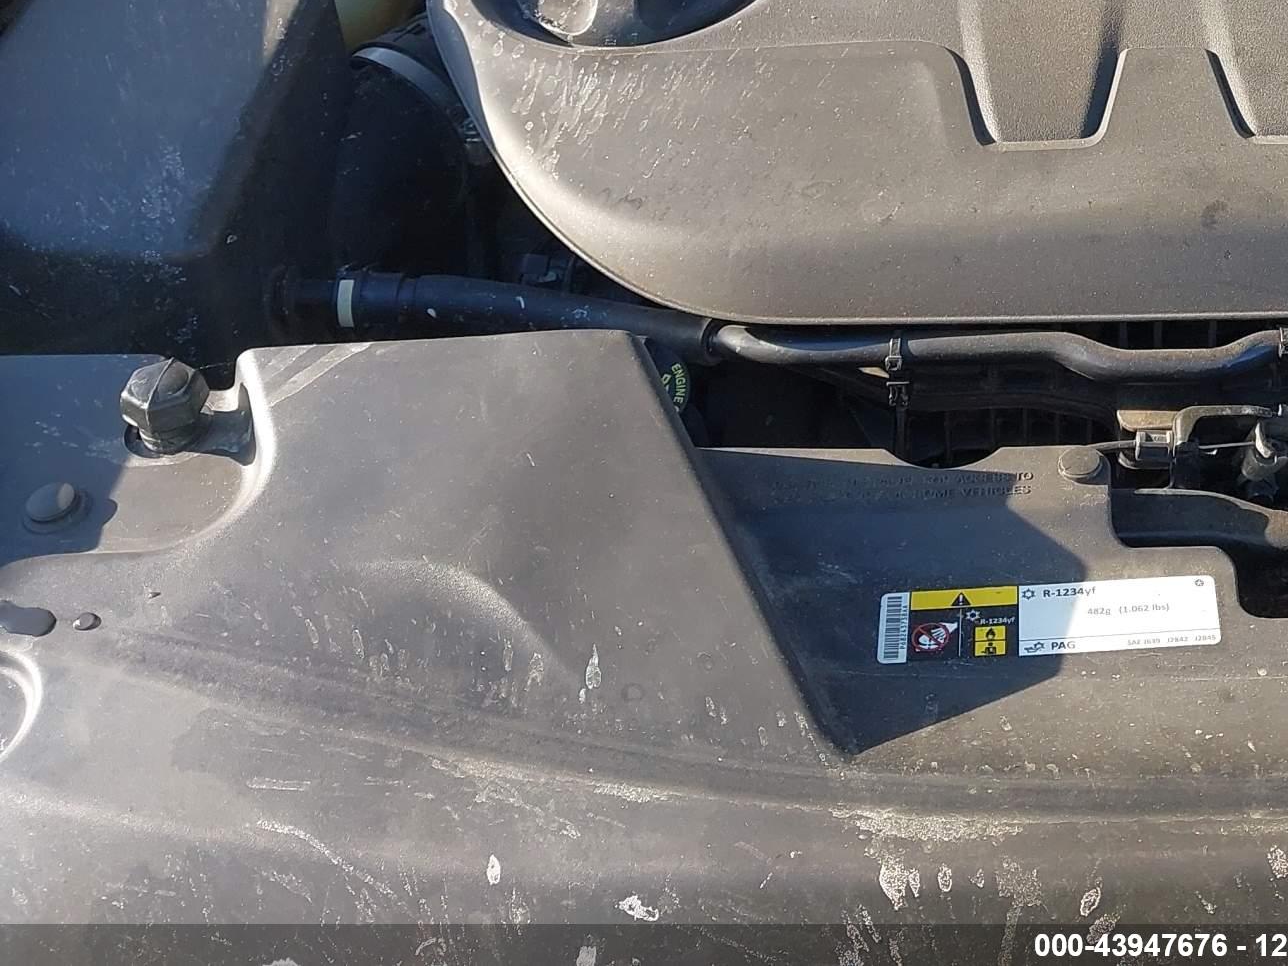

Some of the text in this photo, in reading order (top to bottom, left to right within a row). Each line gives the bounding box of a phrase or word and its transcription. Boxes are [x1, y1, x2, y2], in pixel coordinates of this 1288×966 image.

[671, 363, 686, 403] ENGINE
[1016, 472, 1034, 481] TO
[1042, 586, 1096, 598] R-1234yf
[1087, 603, 1170, 616] 482g (1.062 lbs)
[980, 616, 1016, 625] R-1234yf
[1051, 640, 1076, 651] PAG
